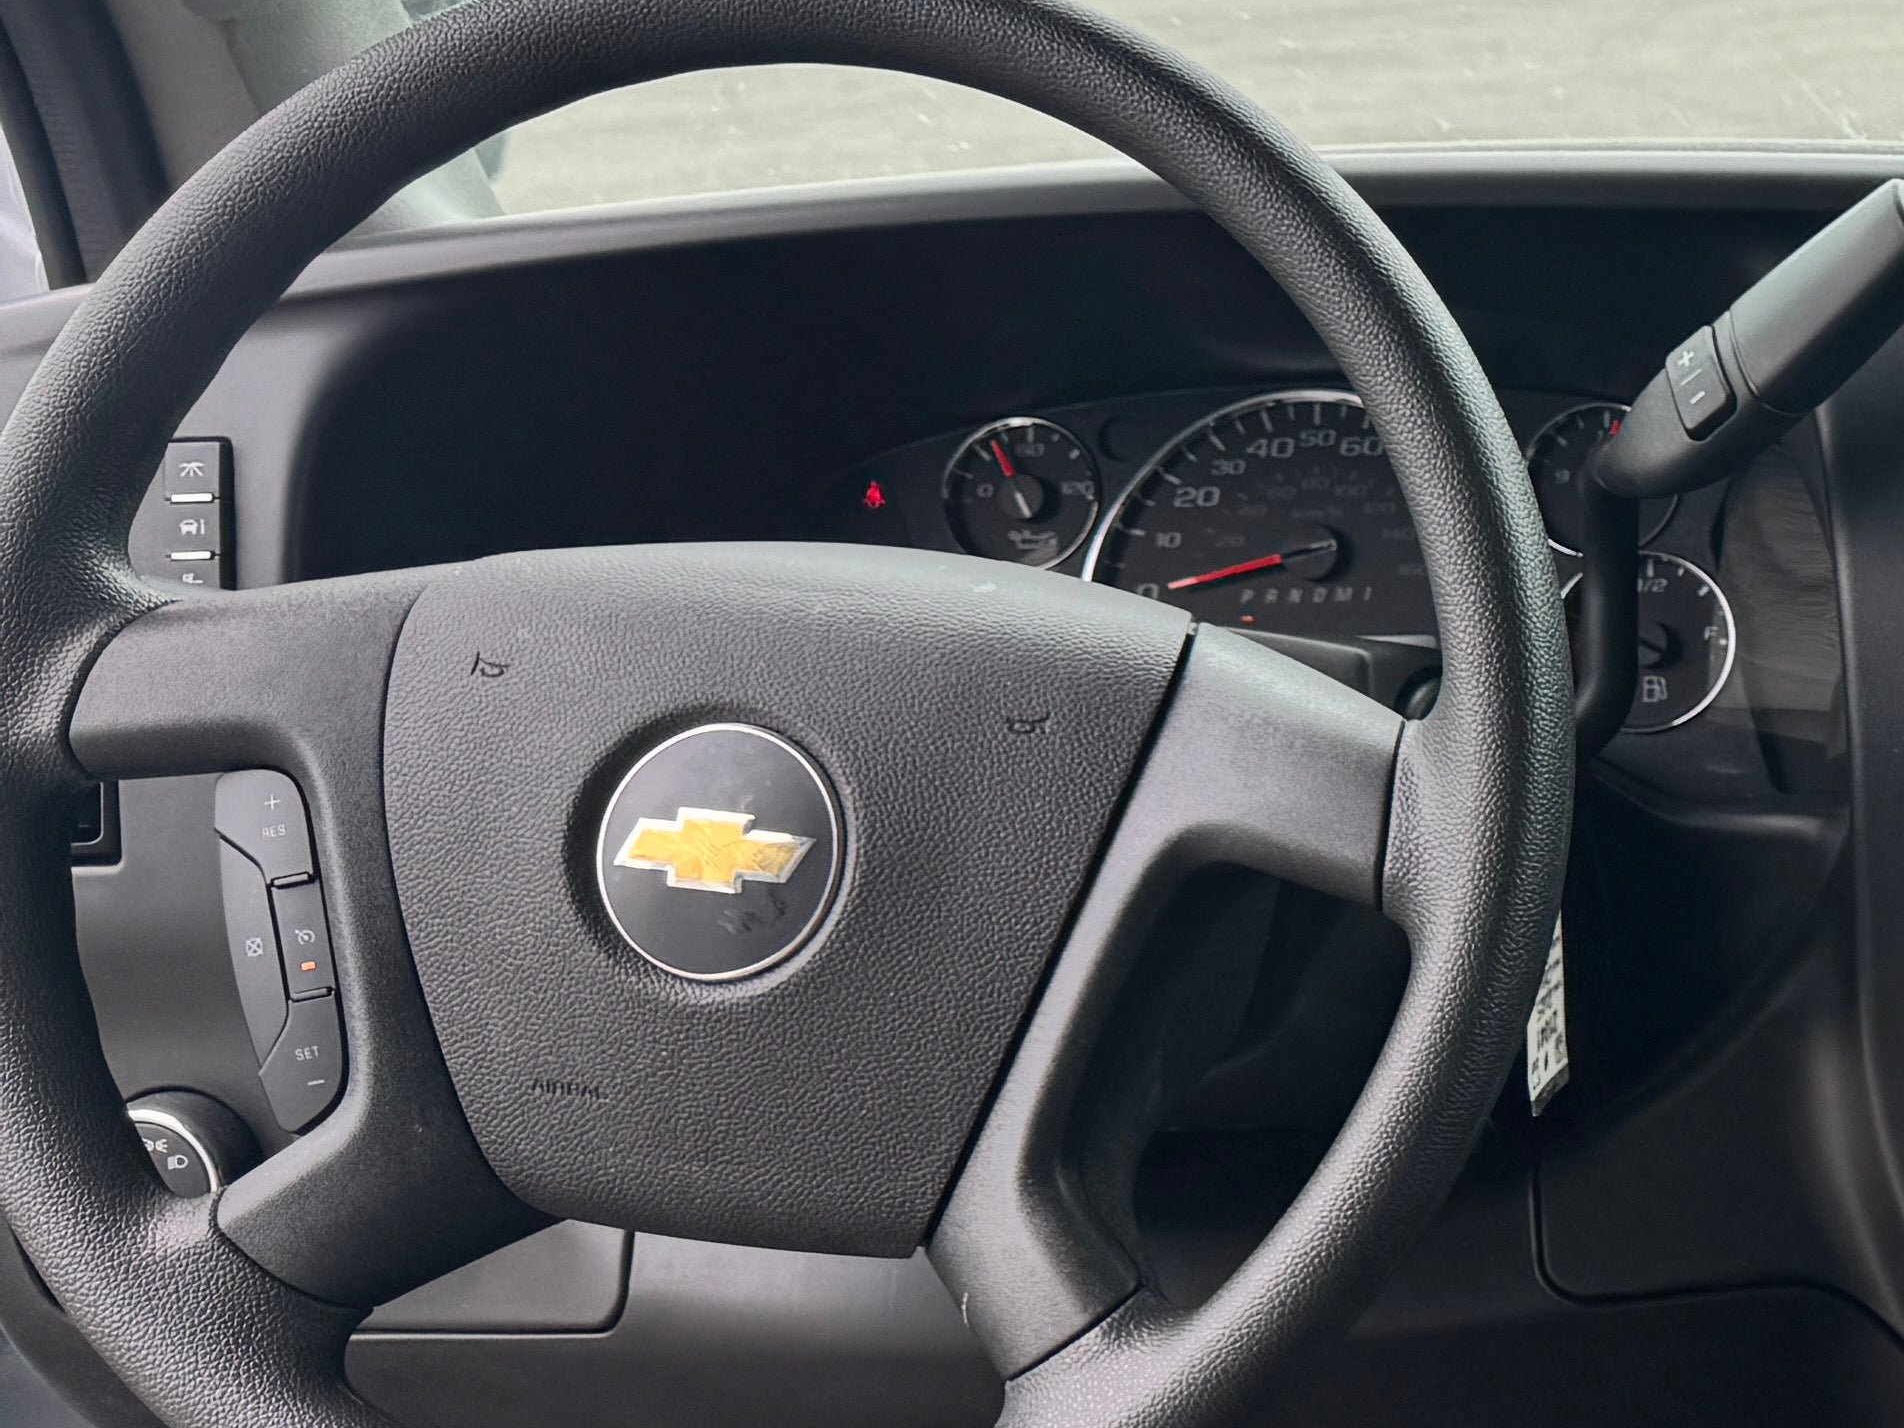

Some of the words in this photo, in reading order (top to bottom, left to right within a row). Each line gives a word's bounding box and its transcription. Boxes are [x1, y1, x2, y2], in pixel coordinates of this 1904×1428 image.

[1245, 436, 1296, 459] 40
[1300, 429, 1337, 448] 50
[1340, 435, 1382, 457] 60
[1209, 458, 1246, 476] 30
[1173, 486, 1220, 508] 20
[1156, 532, 1182, 549] 10
[262, 824, 286, 838] RES
[294, 1045, 319, 1061] SET
